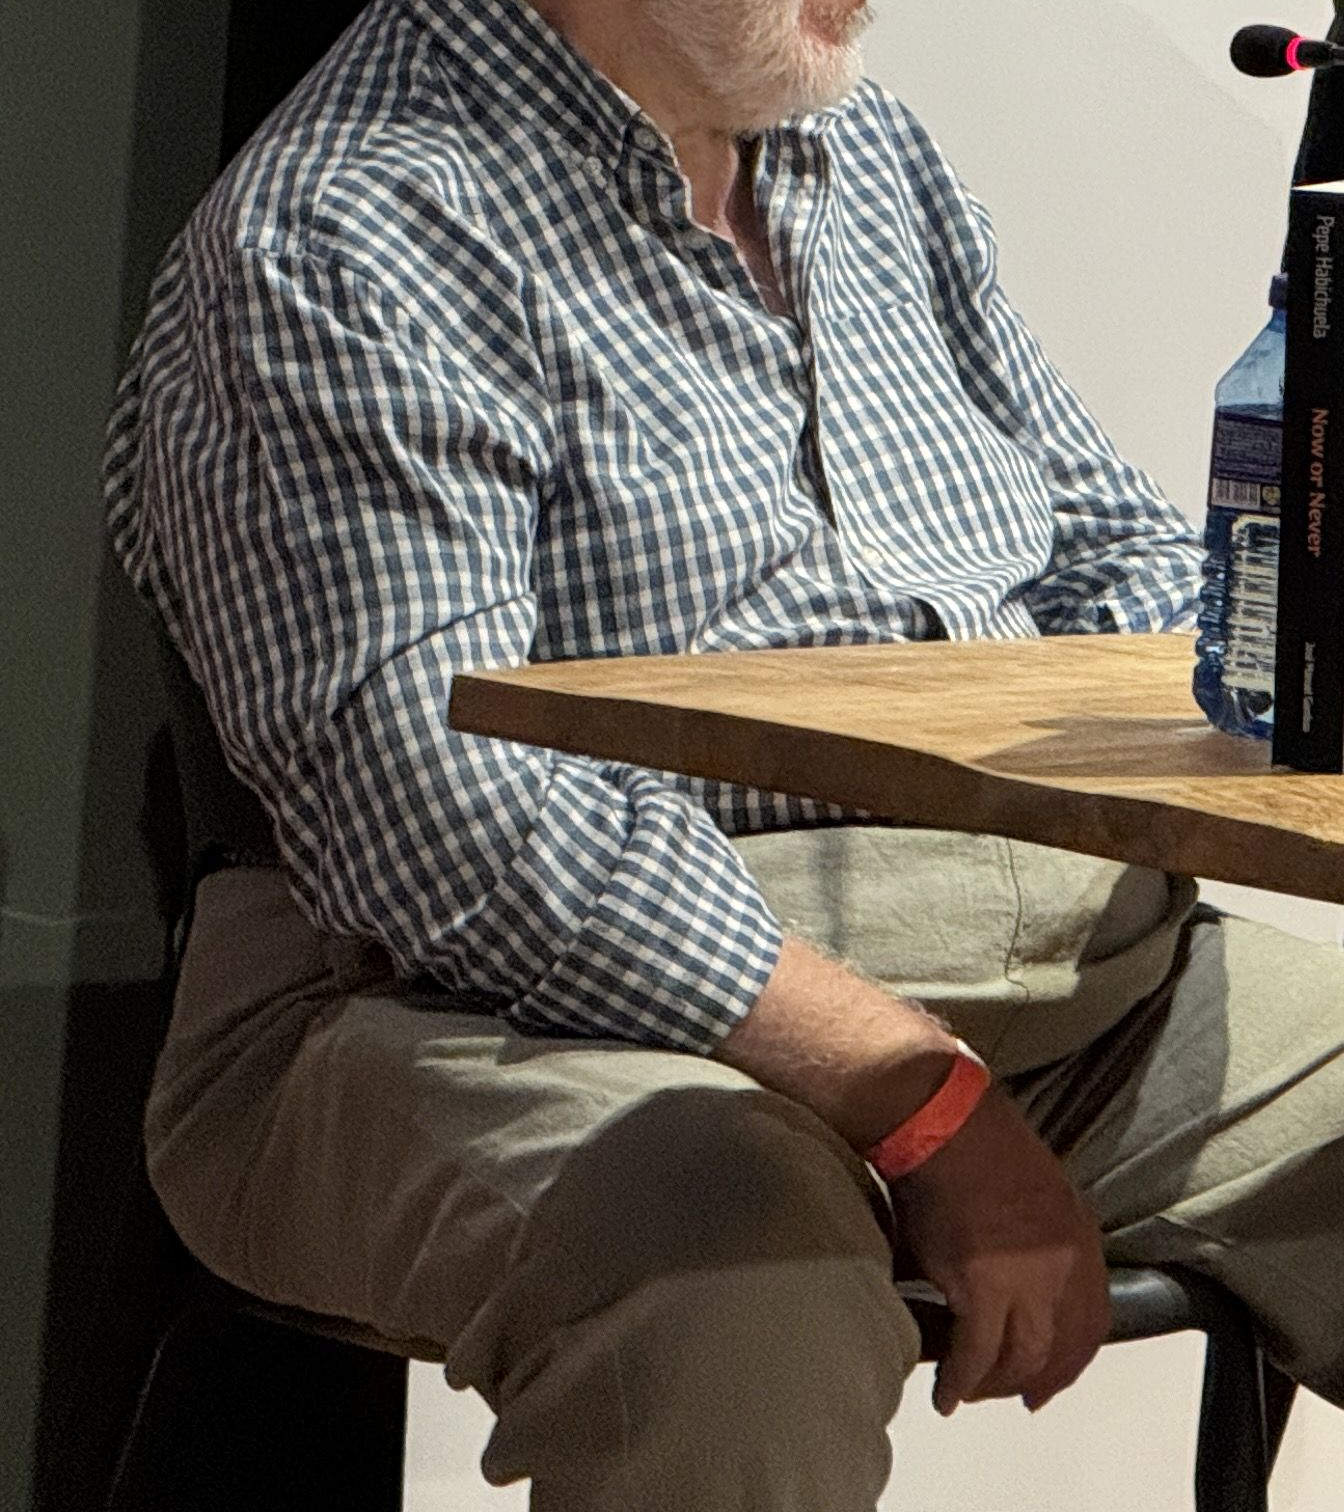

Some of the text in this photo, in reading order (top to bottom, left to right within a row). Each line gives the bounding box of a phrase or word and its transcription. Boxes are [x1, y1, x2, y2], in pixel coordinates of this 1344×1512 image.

[1312, 214, 1336, 340] Pepe Habichuela
[1307, 408, 1331, 558] Now or Never
